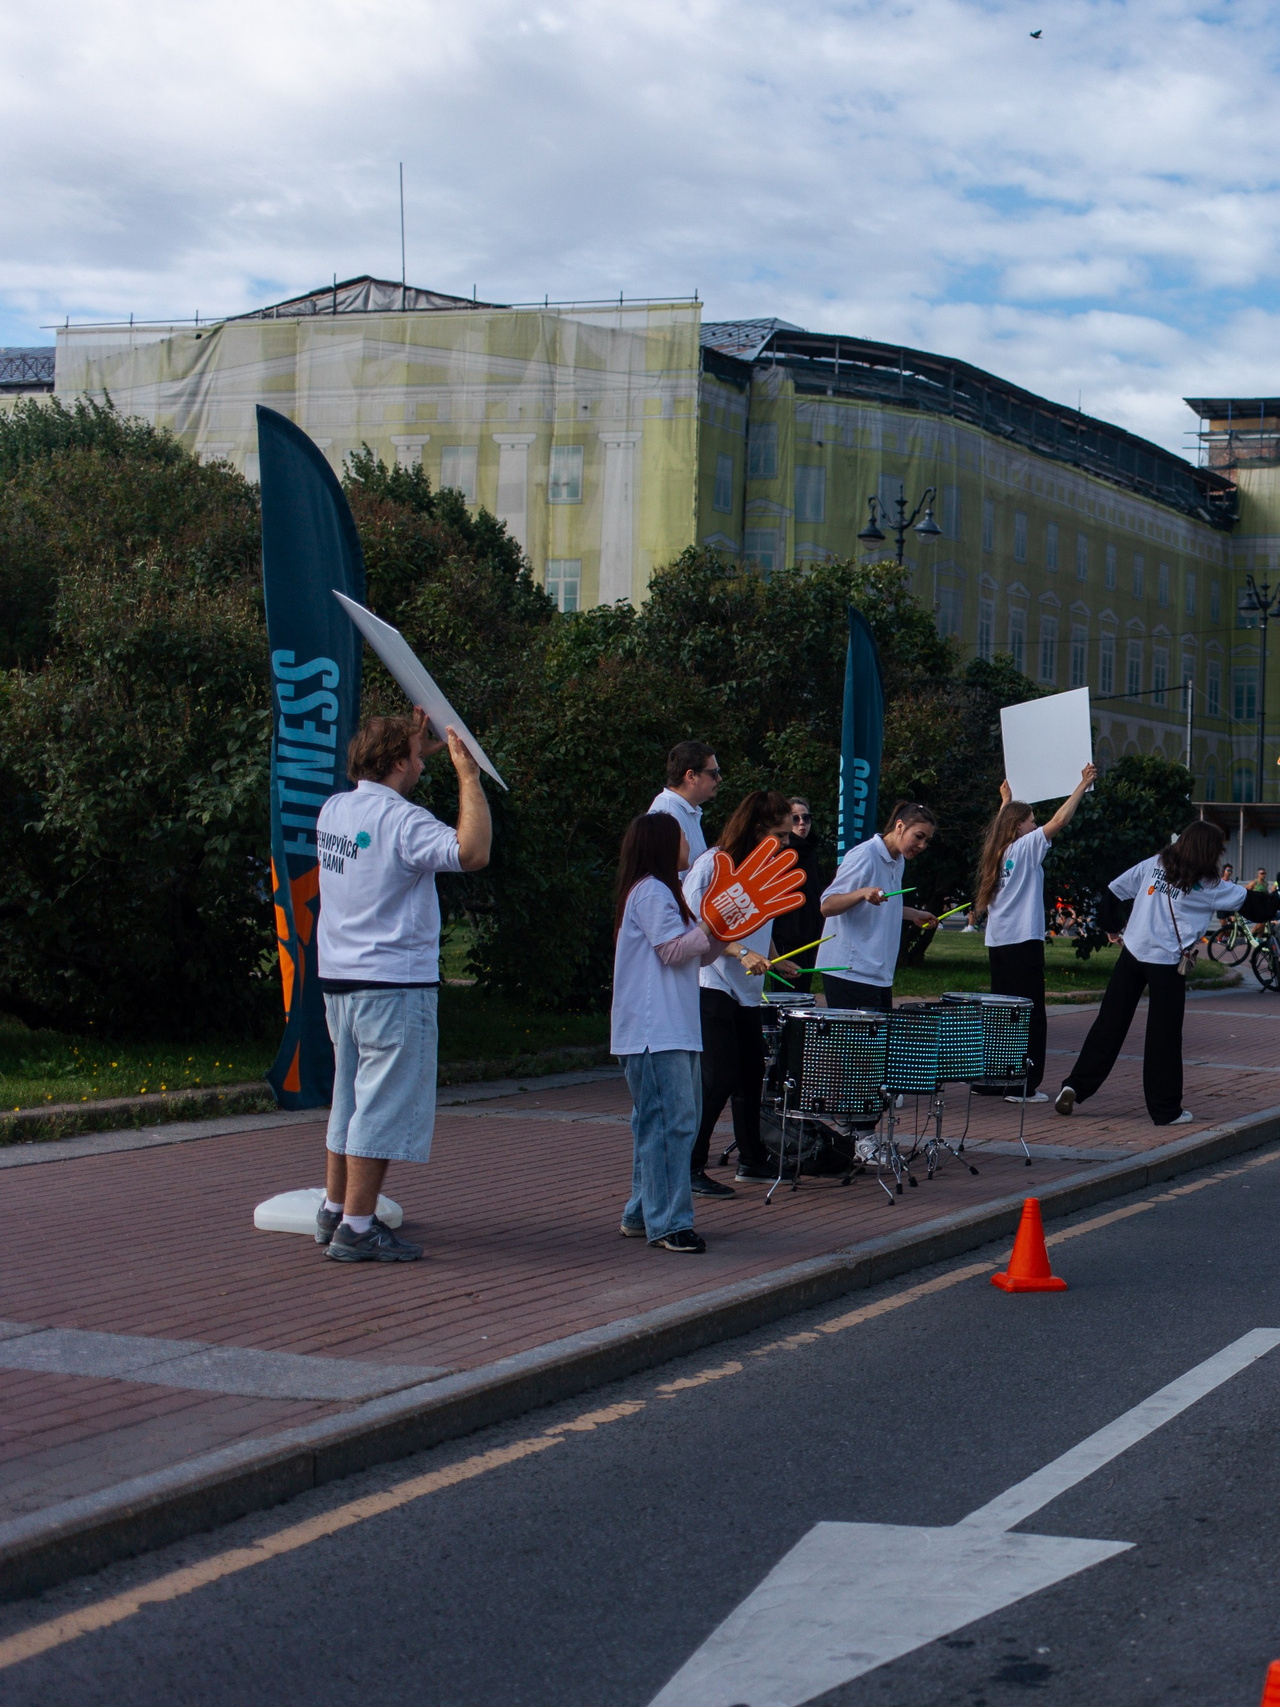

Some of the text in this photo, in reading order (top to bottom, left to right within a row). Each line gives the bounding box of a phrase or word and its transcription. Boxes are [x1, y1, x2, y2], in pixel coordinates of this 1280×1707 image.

[317, 830, 359, 860] ЕНИРУЙСЯ
[322, 851, 345, 875] НАМИ
[726, 881, 760, 921] DDX
[1153, 880, 1181, 900] С НАМИ
[711, 890, 747, 931] FITNESS
